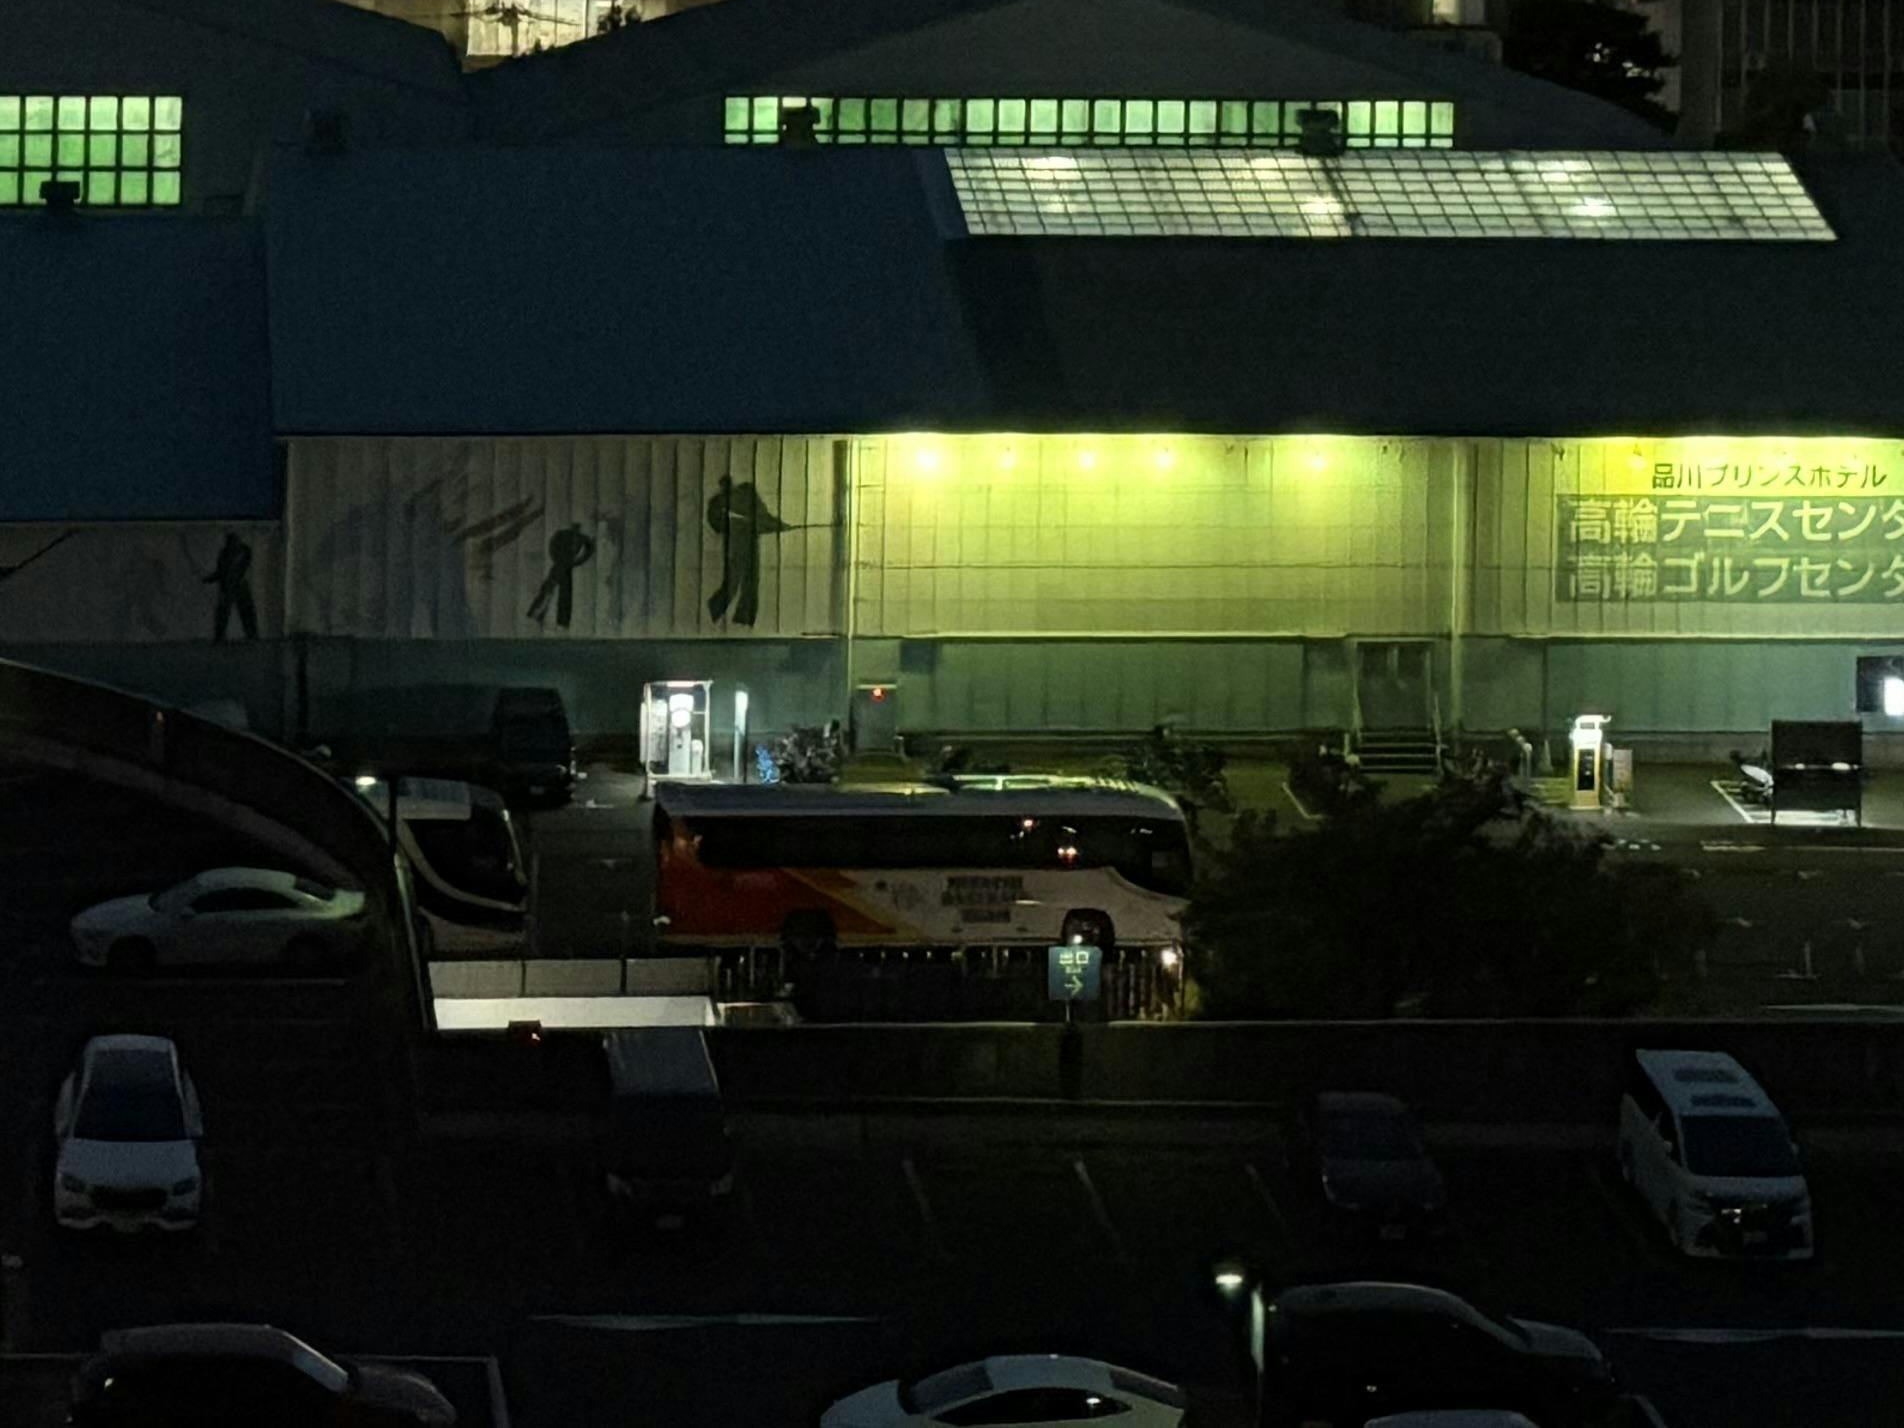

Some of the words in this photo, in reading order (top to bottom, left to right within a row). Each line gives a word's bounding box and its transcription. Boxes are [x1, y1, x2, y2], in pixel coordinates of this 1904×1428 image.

[1651, 463, 1887, 489] 品川プリンスホテル
